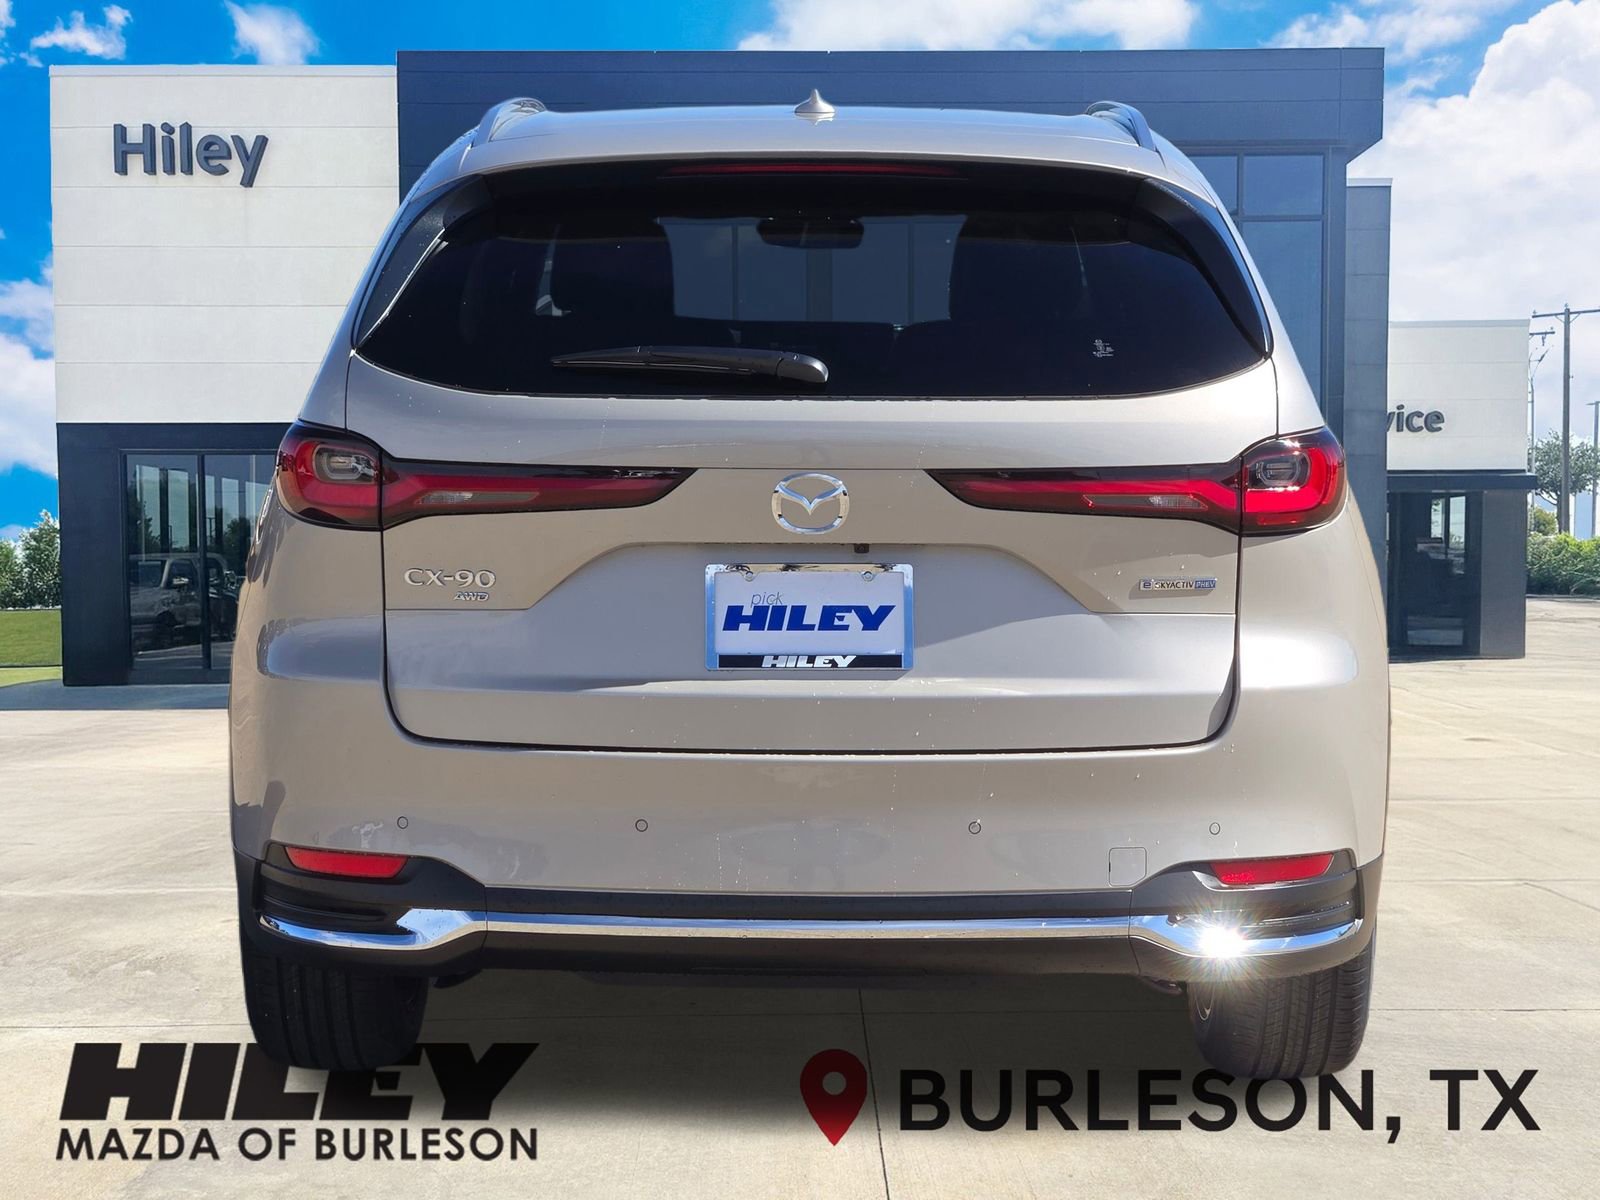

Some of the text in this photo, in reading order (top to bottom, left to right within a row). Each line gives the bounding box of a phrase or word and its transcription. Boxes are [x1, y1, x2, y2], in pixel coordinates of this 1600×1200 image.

[113, 121, 269, 188] Hiley
[404, 567, 496, 588] CX-90
[1154, 581, 1194, 589] SKYACTIV
[1195, 579, 1216, 588] PHEV
[454, 591, 490, 602] AWD
[750, 591, 784, 607] pick
[722, 605, 896, 632] HILEY
[761, 655, 857, 668] HILEY
